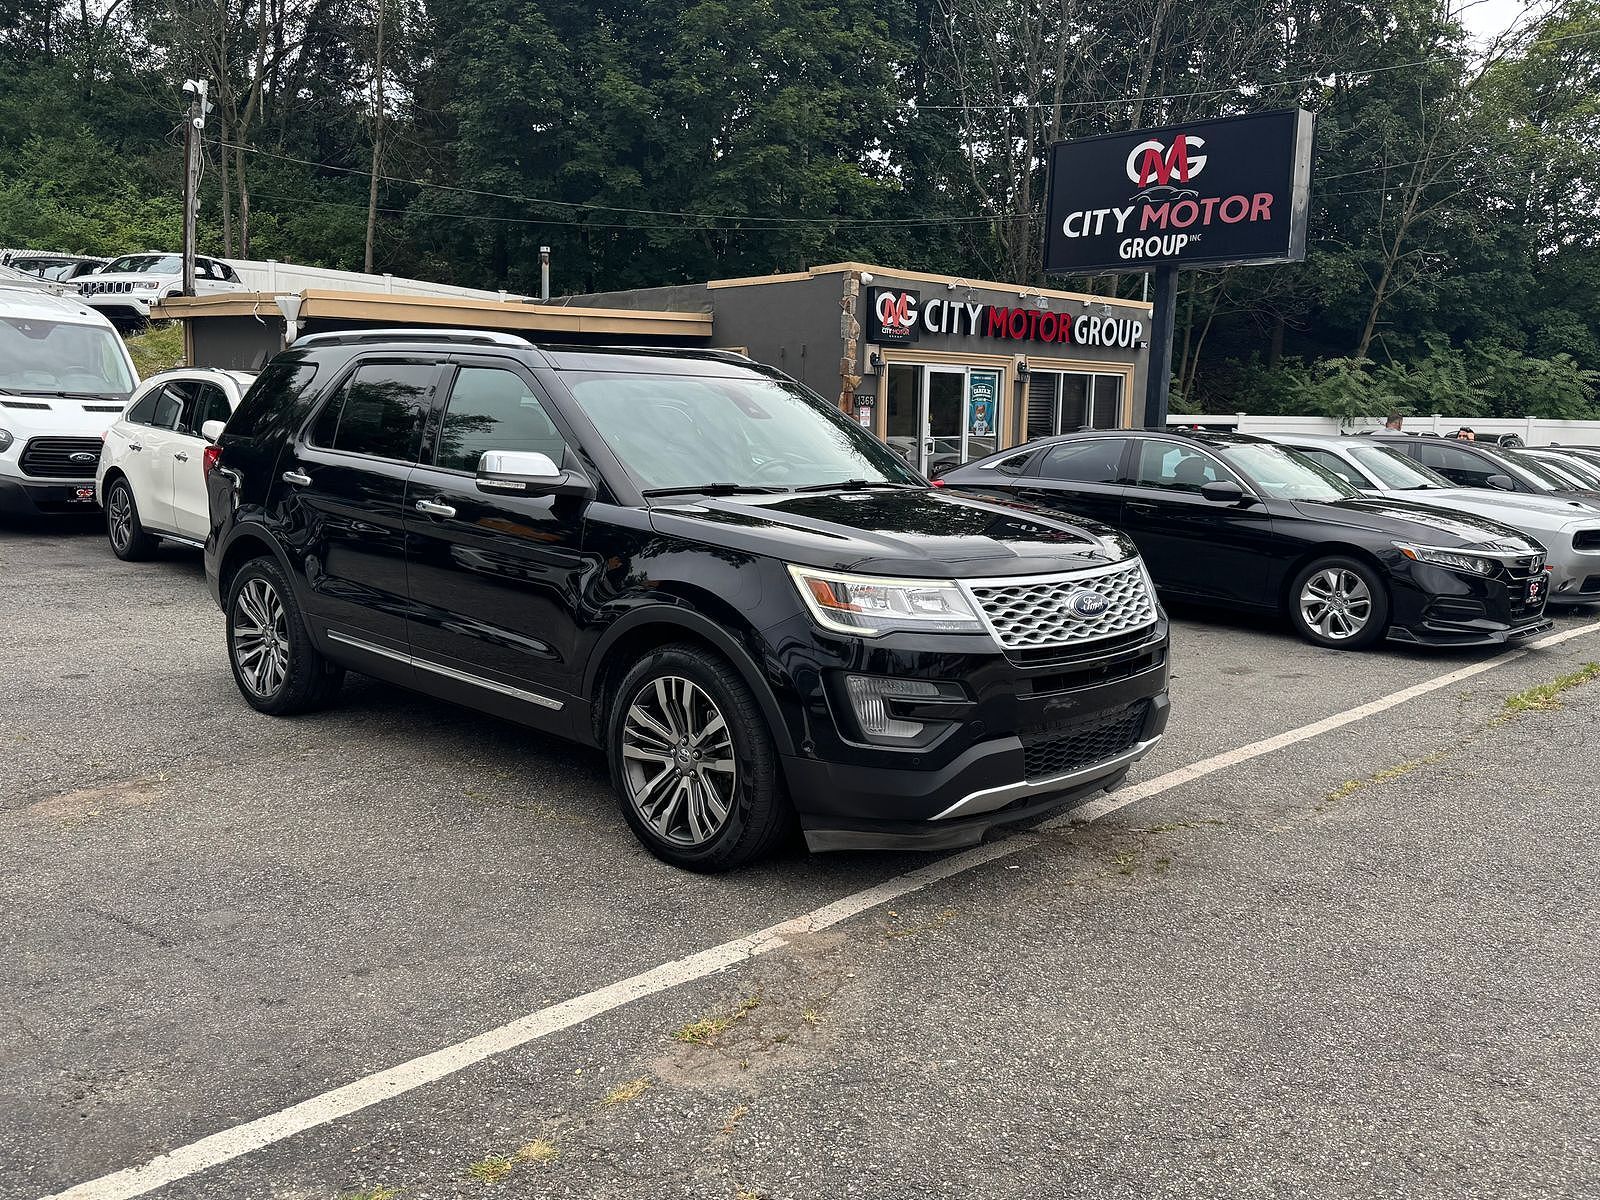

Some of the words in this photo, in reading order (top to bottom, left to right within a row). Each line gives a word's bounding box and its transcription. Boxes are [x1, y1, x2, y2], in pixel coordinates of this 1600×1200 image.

[1063, 205, 1136, 238] CITY
[1139, 192, 1274, 231] MOTOR
[1118, 233, 1188, 260] GROUP
[1189, 233, 1202, 242] INC
[924, 299, 984, 337] CITY
[987, 304, 1073, 343] MOTOR
[1074, 314, 1143, 349] GROUP
[857, 395, 874, 406] 1368
[1083, 596, 1104, 611] Ford
